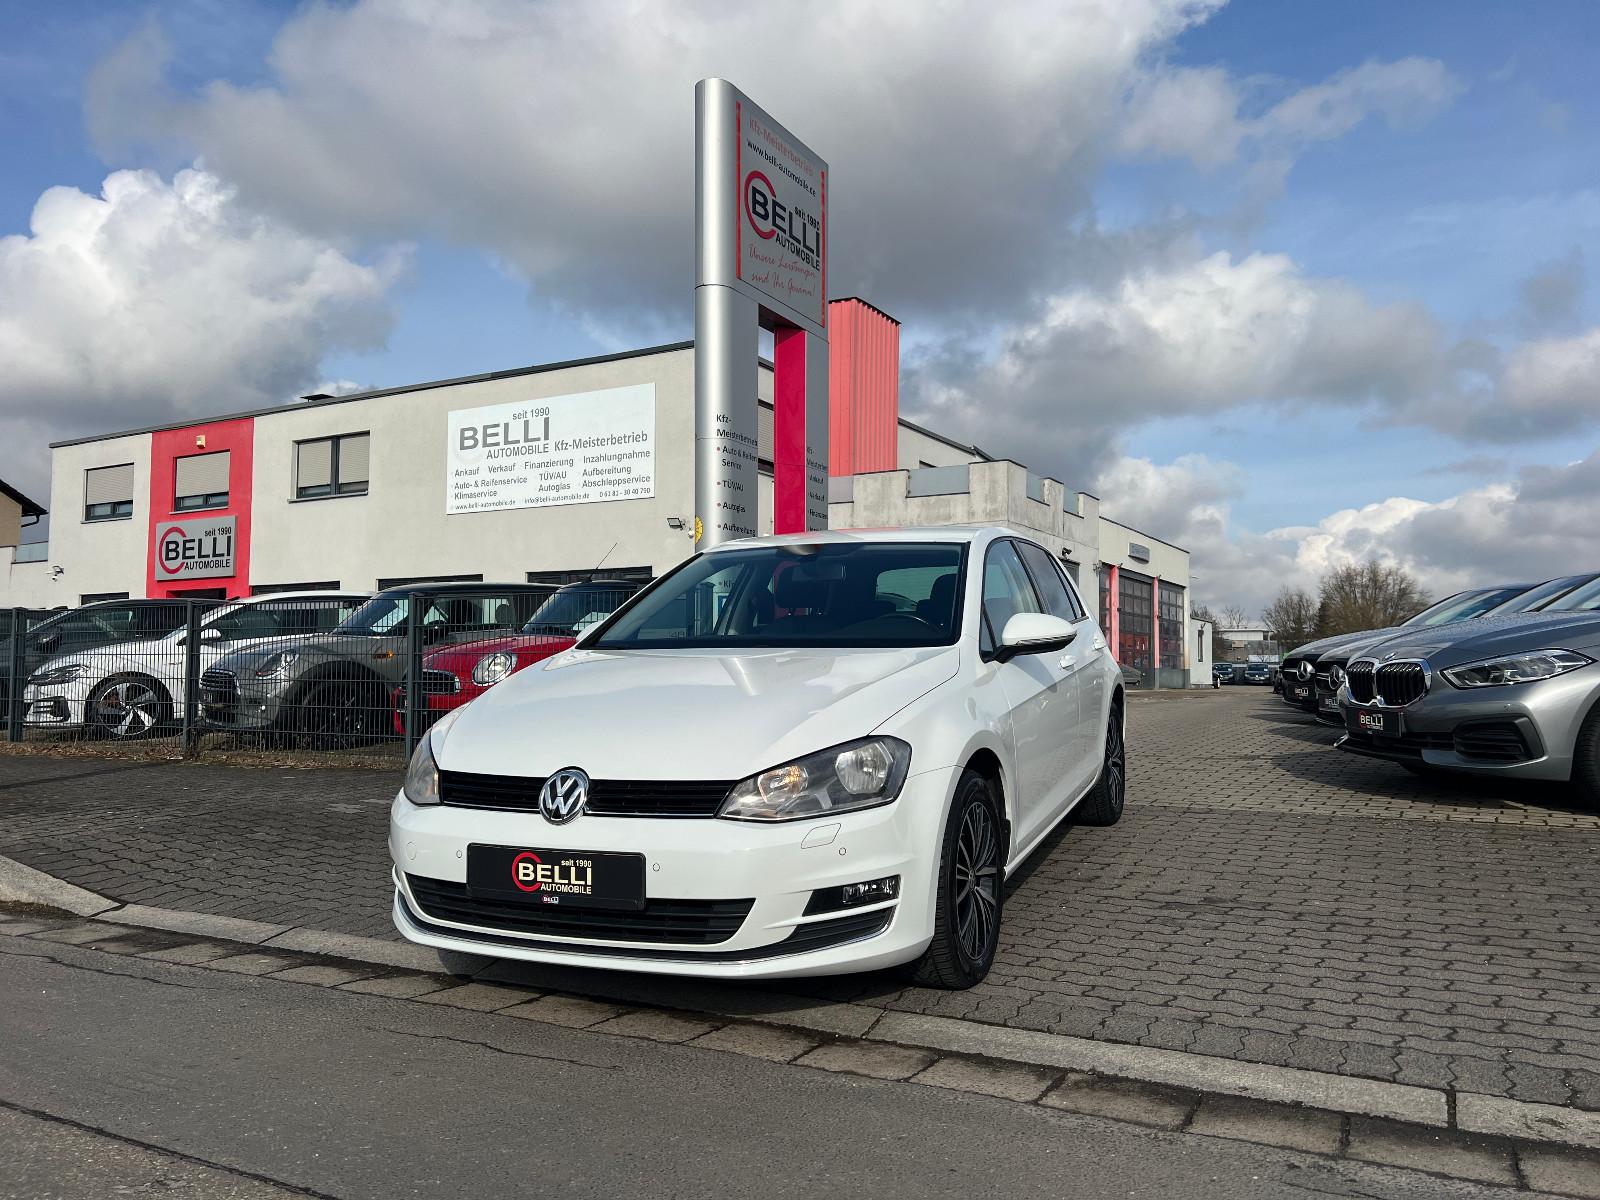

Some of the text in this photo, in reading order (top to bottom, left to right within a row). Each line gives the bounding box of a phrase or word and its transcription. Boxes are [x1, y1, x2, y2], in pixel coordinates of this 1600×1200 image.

[752, 185, 820, 258] BELLI
[776, 232, 820, 272] AUTOMOBILE
[512, 407, 550, 420] seit 1990
[716, 414, 732, 423] Kfz-
[460, 417, 550, 450] BELLI
[554, 430, 648, 452] Kfz-Meisterbetrieb
[486, 443, 549, 459] AUTOMOBILE
[454, 450, 651, 477] Ankauf Verkauf Finanzierung Inzahlungnahme
[454, 481, 473, 489] Auto-
[481, 476, 528, 487] Reifenservice
[539, 471, 567, 480] TÜV/AU
[582, 466, 632, 477] Aufbereitung
[454, 475, 651, 500] Klimaservice Autoglas Abschleppservice
[204, 526, 232, 537] seit 1990
[165, 535, 232, 561] BELLI
[184, 559, 231, 571] AUTOMOBILE
[1360, 714, 1383, 726] BELLI
[518, 862, 592, 886] BELLI
[561, 859, 592, 868] seit 1990
[540, 883, 592, 895] AUTOMOBILE
